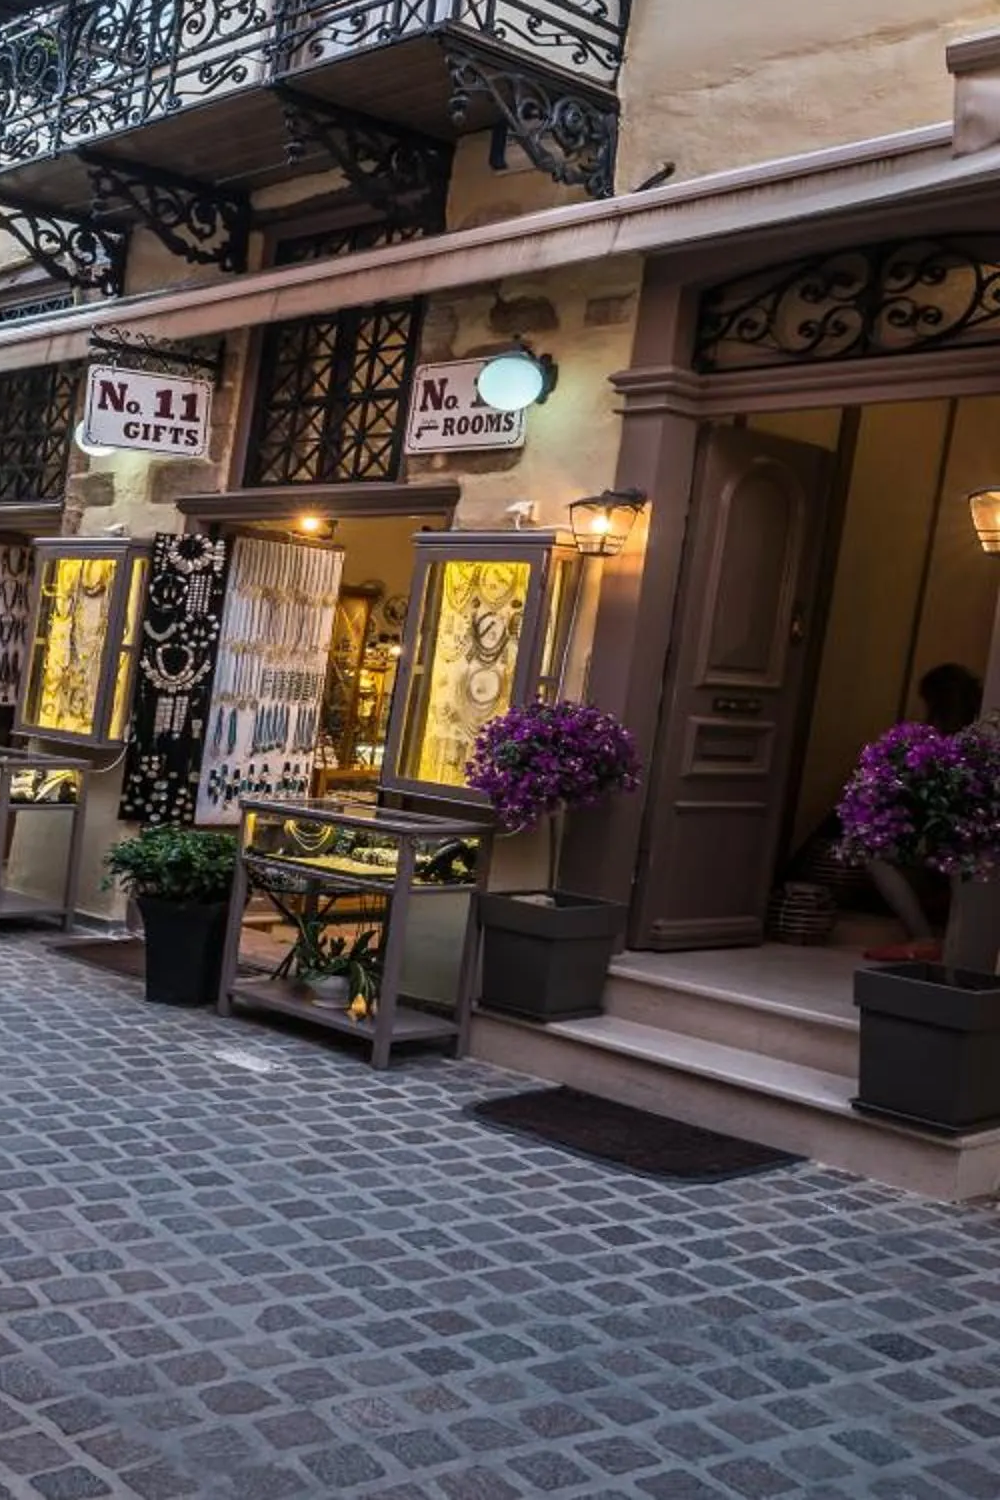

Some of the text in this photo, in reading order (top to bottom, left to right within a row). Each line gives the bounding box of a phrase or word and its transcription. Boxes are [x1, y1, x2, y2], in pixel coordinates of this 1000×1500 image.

[98, 380, 201, 423] No. 11
[123, 421, 200, 447] GIFTS
[442, 412, 515, 436] ROOMS
